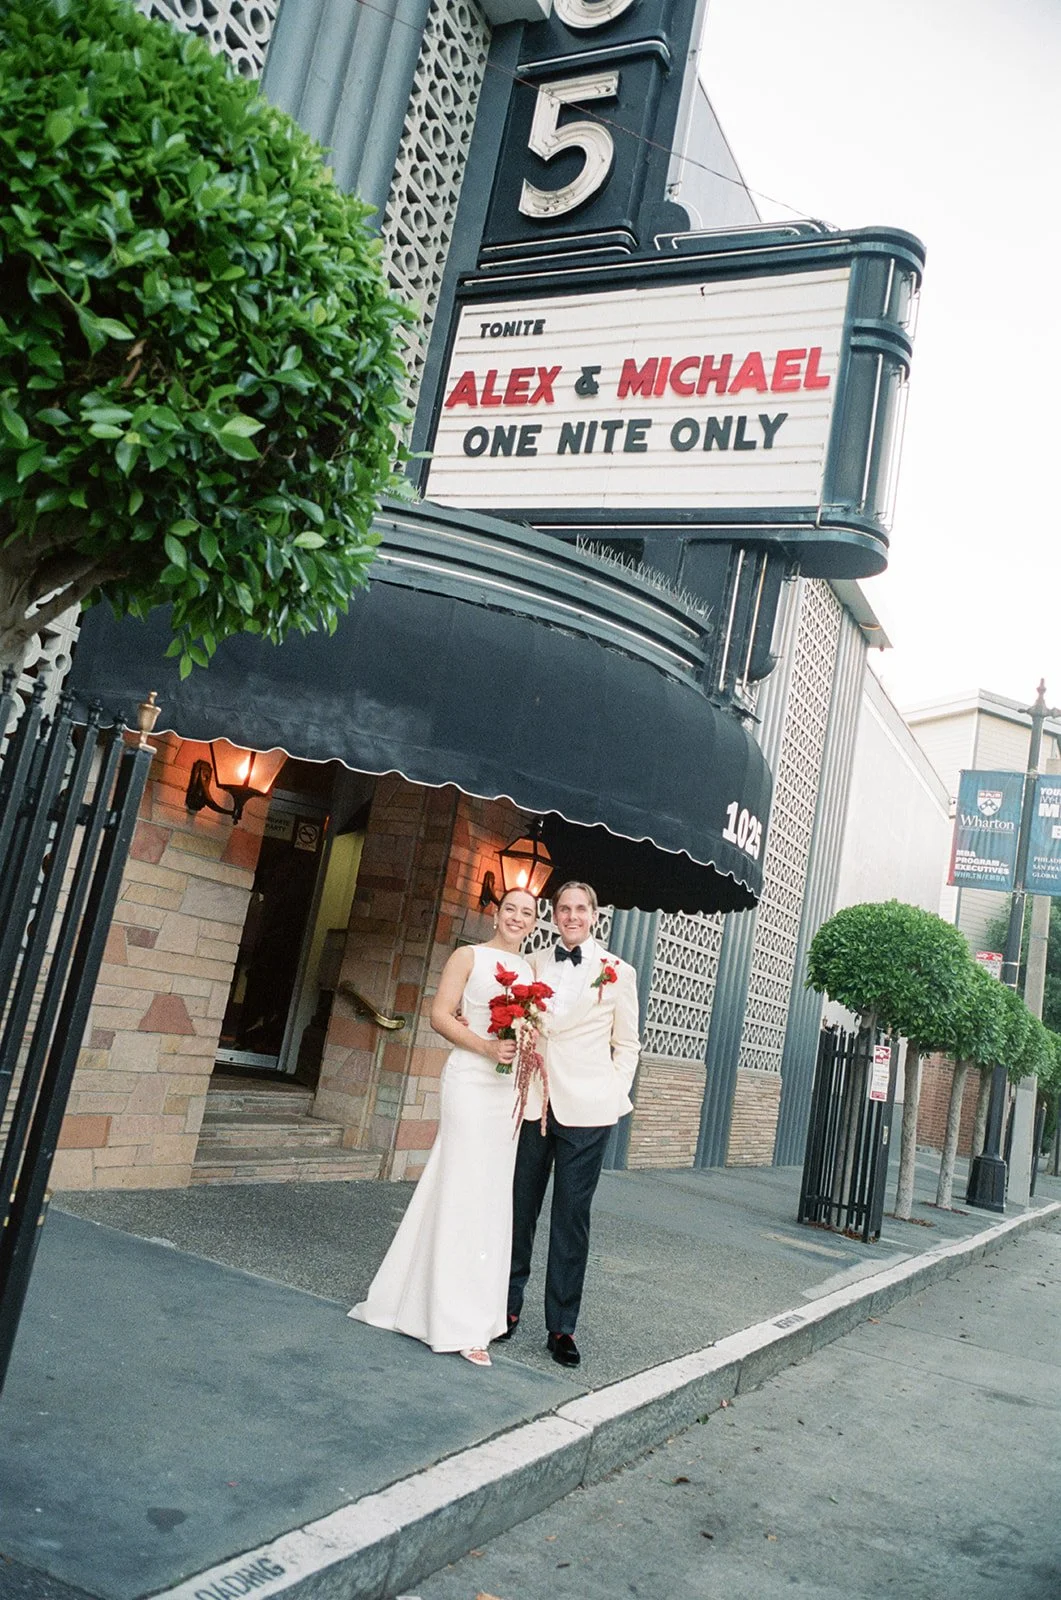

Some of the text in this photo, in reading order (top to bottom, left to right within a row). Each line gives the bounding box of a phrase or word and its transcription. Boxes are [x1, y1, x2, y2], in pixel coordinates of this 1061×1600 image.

[480, 318, 546, 338] TONITE
[445, 346, 831, 408] ALEX & MICHAEL
[463, 412, 788, 458] ONE NITE ONLY
[1040, 787, 1061, 796] YOU
[960, 814, 1015, 830] Wharton
[956, 849, 976, 858] MBA
[955, 857, 1000, 866] PROGRAM
[955, 863, 1010, 875] EXECUTIVES
[1032, 872, 1058, 880] GLOBAL
